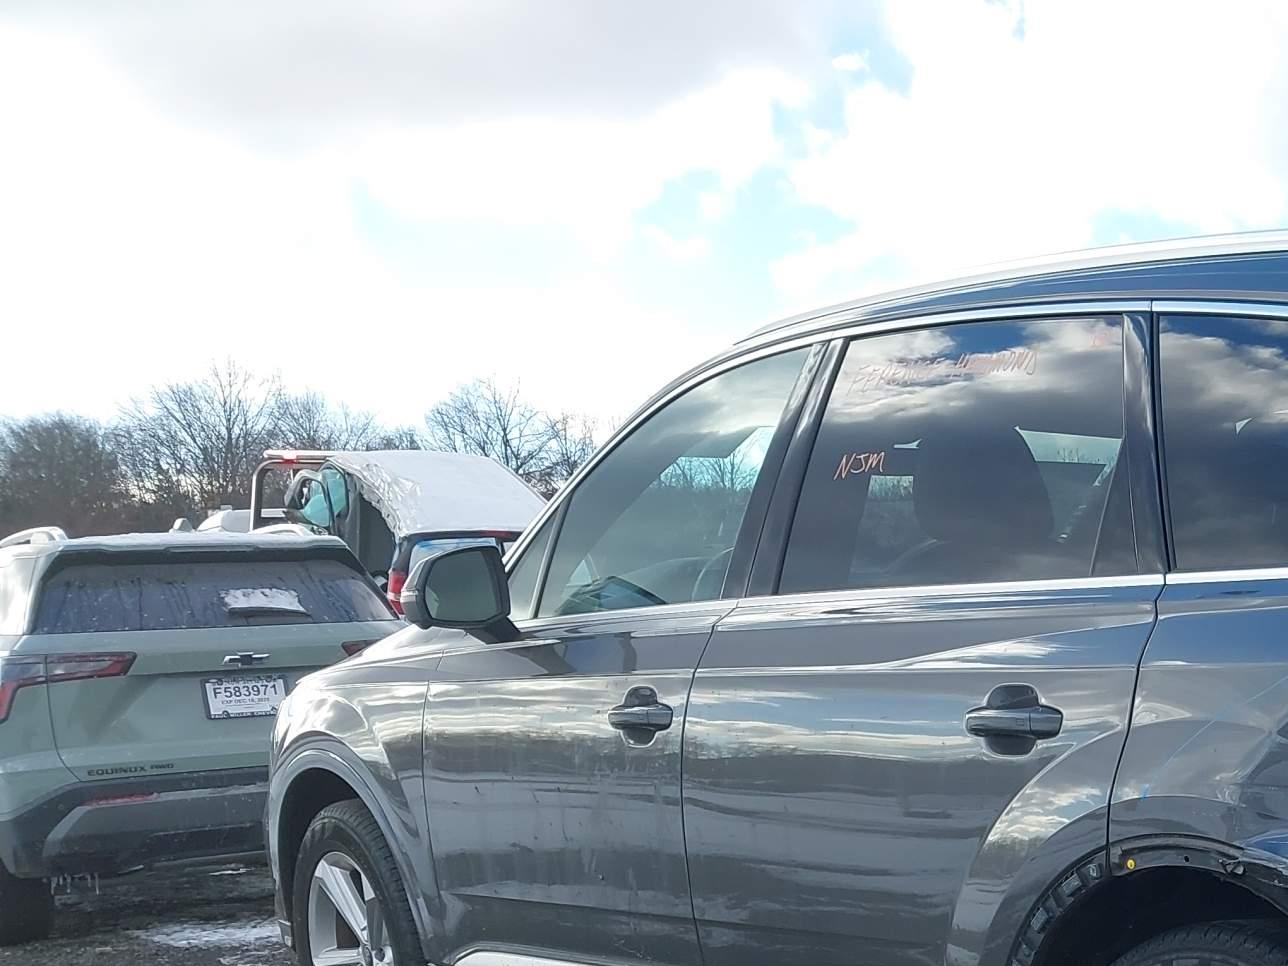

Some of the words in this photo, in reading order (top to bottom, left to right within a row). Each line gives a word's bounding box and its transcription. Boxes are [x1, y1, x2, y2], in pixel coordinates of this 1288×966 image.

[833, 451, 885, 481] NJM
[213, 684, 277, 699] F583971
[88, 767, 147, 776] EQUINOX
